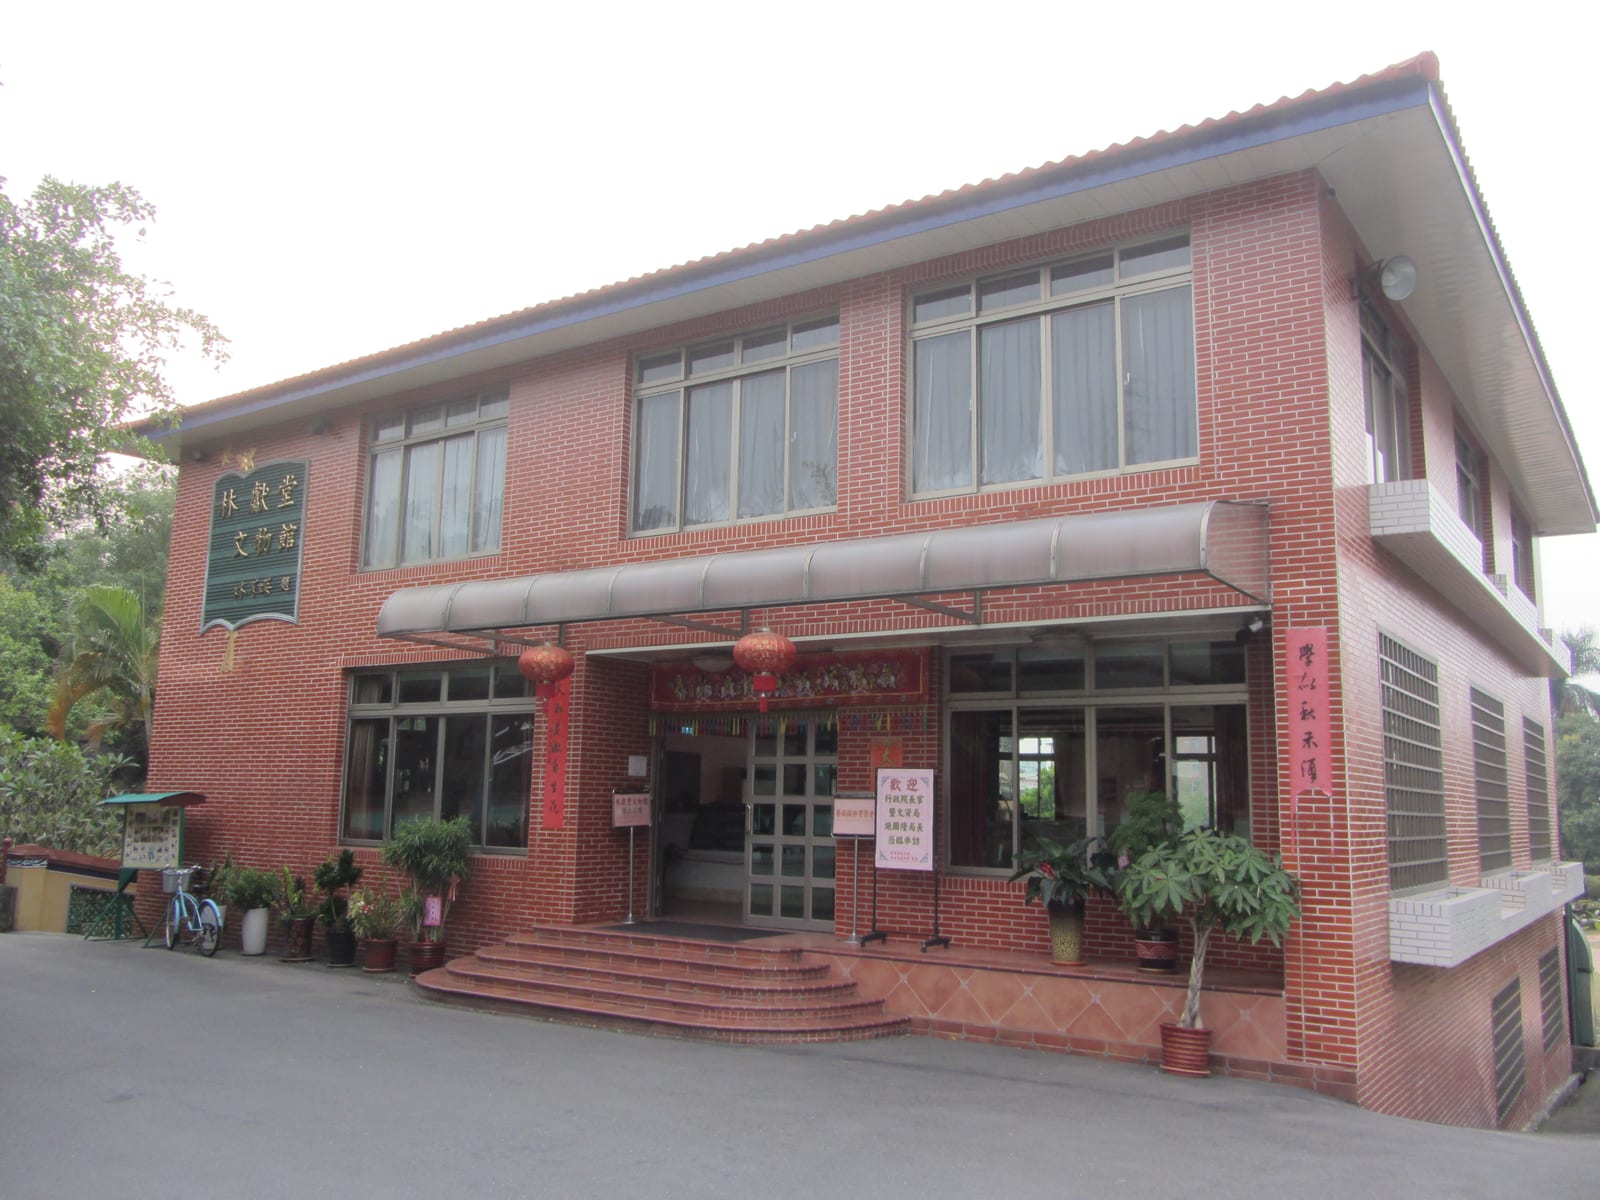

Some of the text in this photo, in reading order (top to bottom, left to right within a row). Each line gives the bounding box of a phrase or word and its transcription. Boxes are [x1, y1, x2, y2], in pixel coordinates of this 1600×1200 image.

[221, 475, 297, 518] 林獻堂
[233, 523, 297, 558] 文物館
[890, 778, 918, 792] 歡迎
[884, 795, 924, 805] 行政院長官
